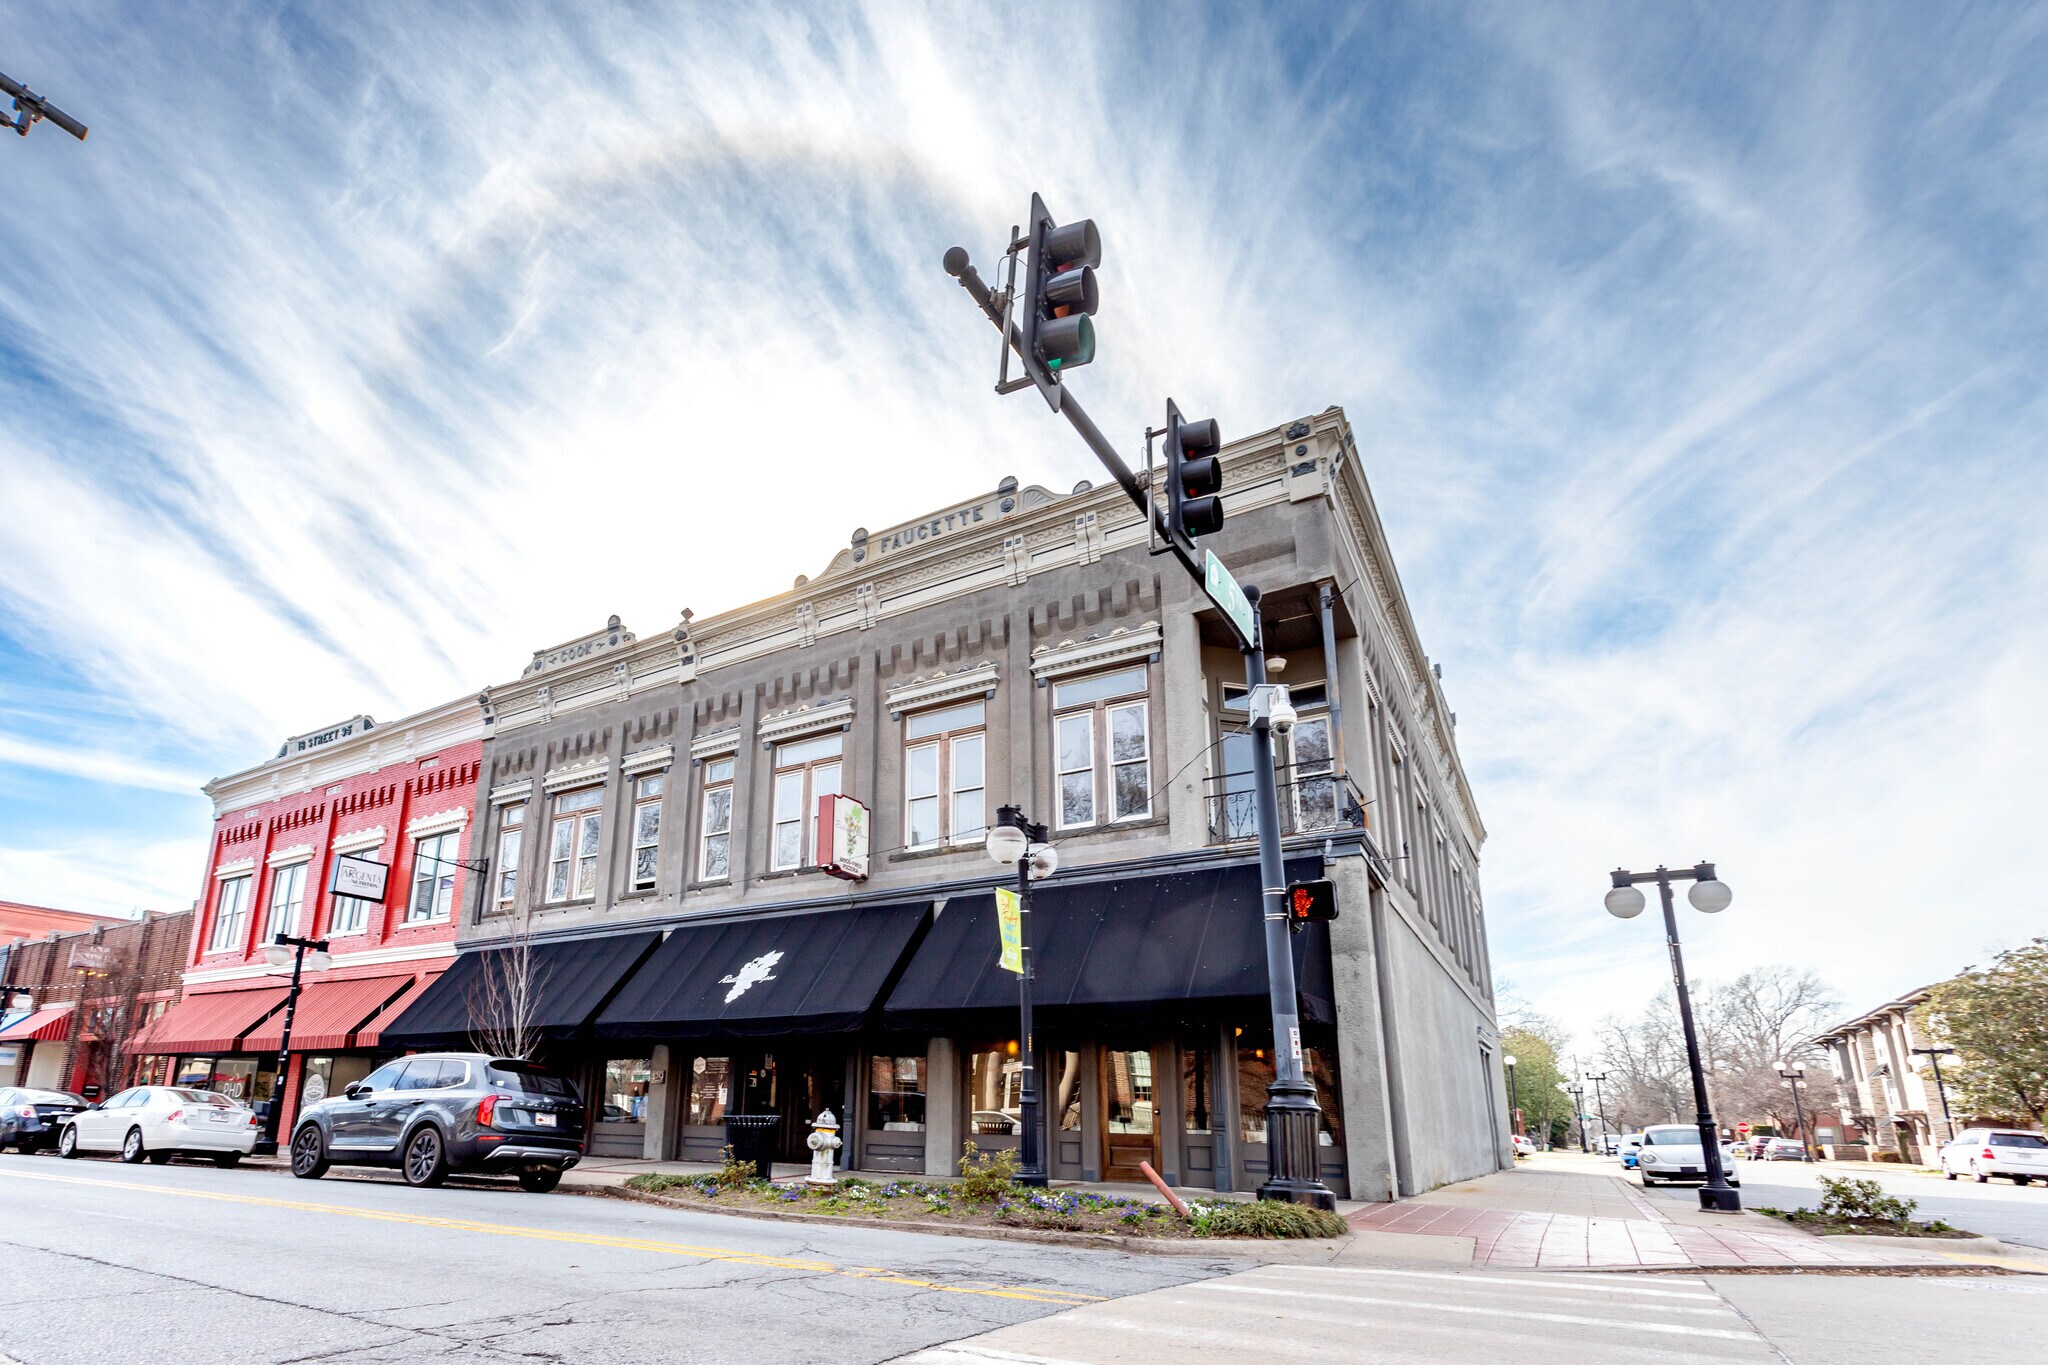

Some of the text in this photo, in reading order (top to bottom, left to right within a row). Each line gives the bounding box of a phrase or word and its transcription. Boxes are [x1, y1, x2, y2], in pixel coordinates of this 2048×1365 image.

[880, 505, 984, 553] FAUCETTE
[560, 641, 593, 663] COOK
[307, 729, 340, 748] STREET
[341, 725, 353, 737] 95
[341, 865, 382, 884] ARGENTA
[223, 1082, 243, 1098] PHD
